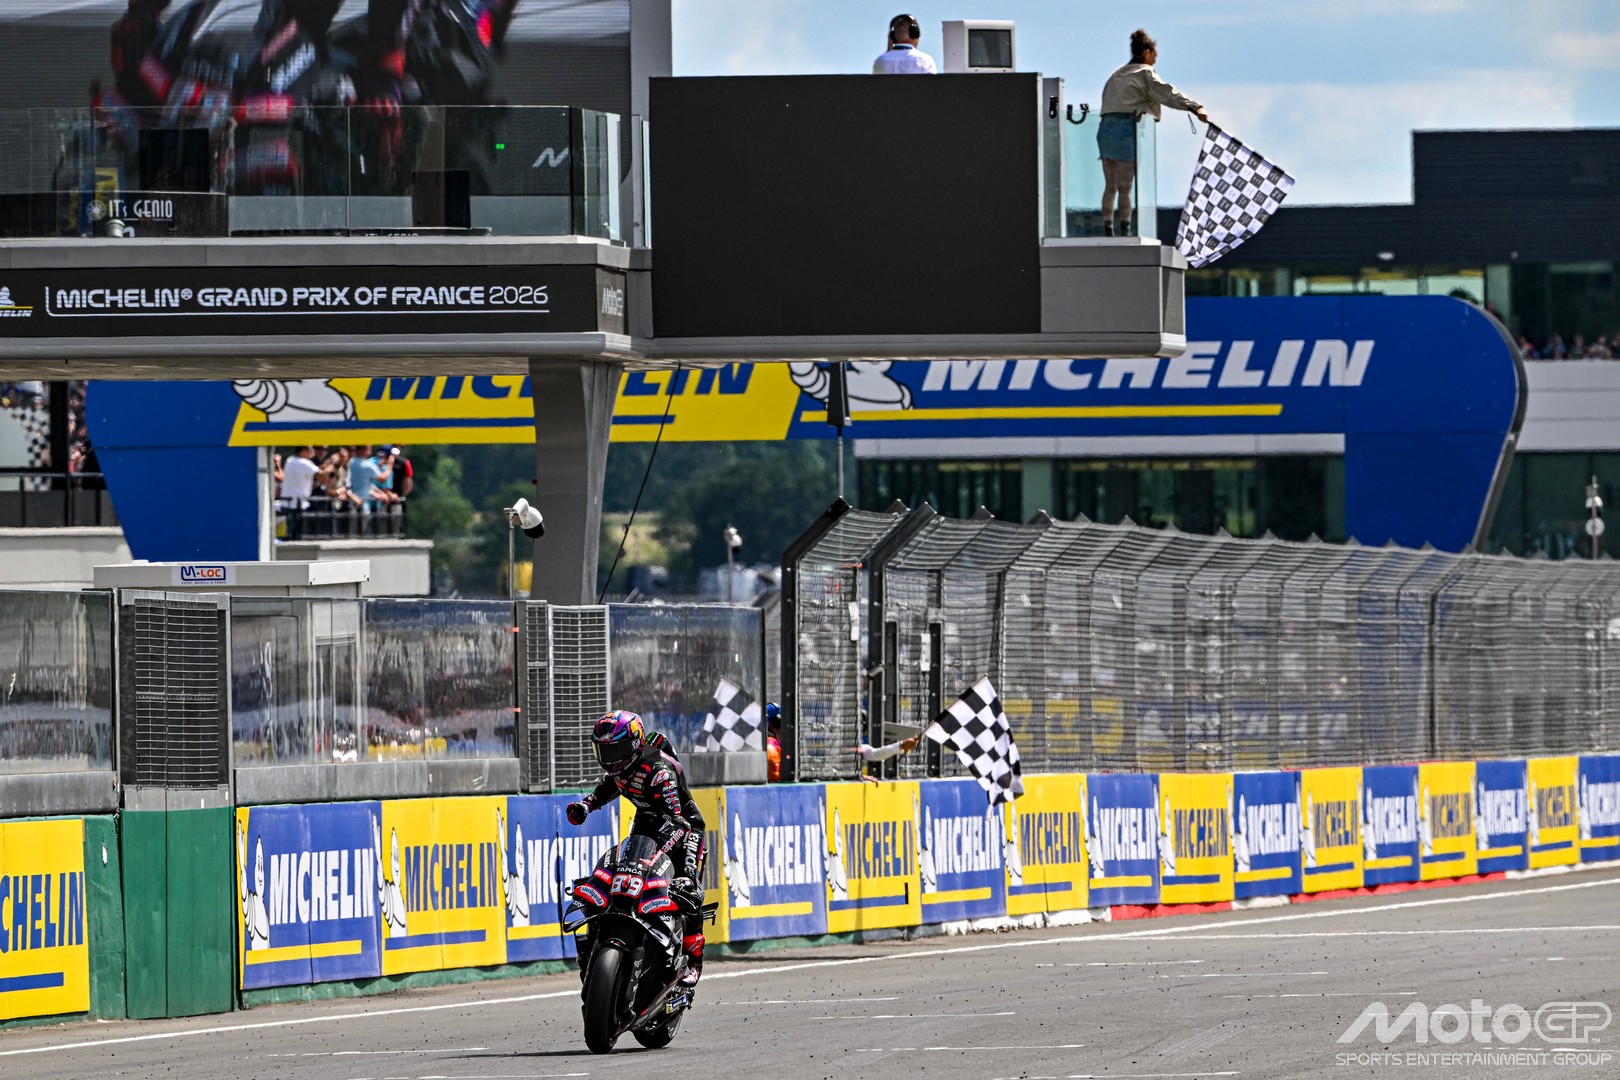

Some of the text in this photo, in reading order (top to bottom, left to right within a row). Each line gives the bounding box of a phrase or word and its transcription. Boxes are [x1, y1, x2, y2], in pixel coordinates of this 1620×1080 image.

[133, 199, 173, 218] GENIO
[197, 287, 287, 307] GRAND
[292, 286, 350, 306] PRIX
[353, 286, 388, 306] OF
[391, 286, 485, 305] FRANCE
[488, 285, 549, 304] 2026
[921, 339, 1375, 392] MICHELIN
[181, 566, 222, 579] M-LOC
[661, 827, 685, 853] aprilia
[845, 820, 915, 879] MICHELIN
[934, 815, 1001, 875] MICHELIN
[1020, 812, 1081, 867] MICHELIN
[1100, 807, 1157, 861] MICHELIN
[1174, 808, 1229, 859] MICHELIN
[1247, 803, 1299, 855] MICHELIN
[1313, 800, 1359, 849] MICHELIN
[404, 842, 498, 913] MICHELIN
[745, 824, 822, 887] MICHELIN
[270, 848, 374, 926] MICHELIN
[611, 874, 644, 898] 89
[641, 898, 670, 912] sterilgarda
